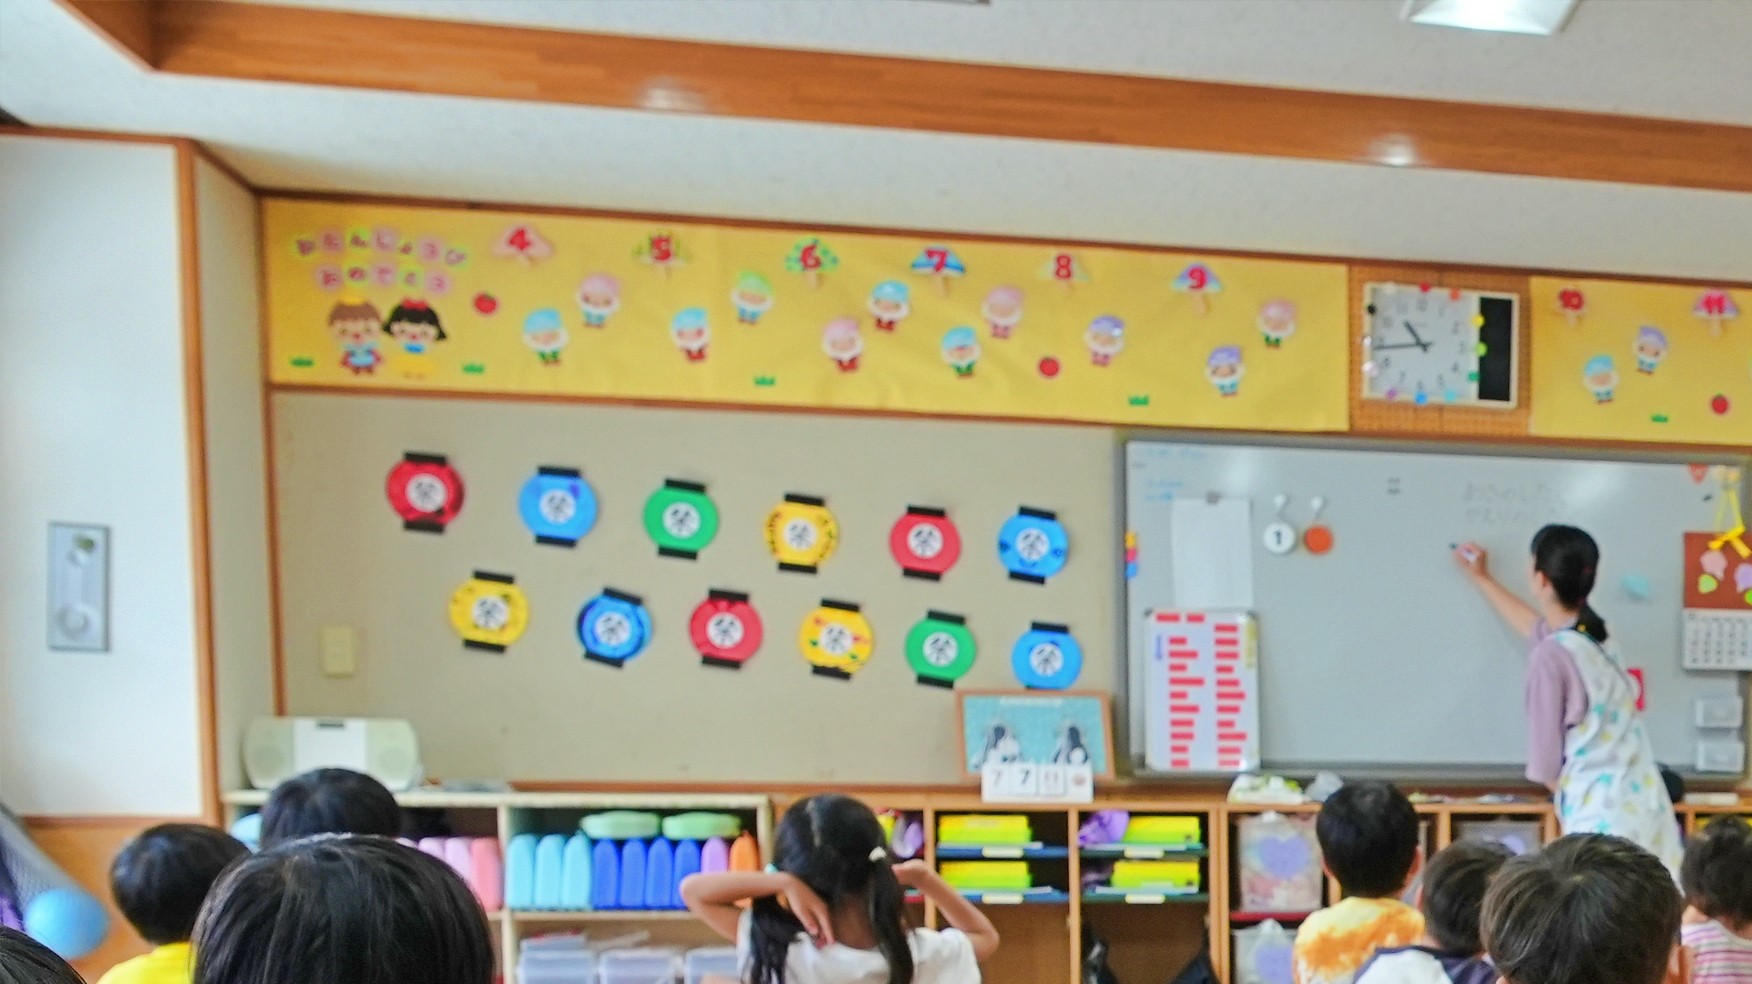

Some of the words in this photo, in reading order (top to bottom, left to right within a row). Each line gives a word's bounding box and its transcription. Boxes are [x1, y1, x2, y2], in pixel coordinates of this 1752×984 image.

[508, 227, 532, 251] 4
[653, 236, 672, 261] 5
[801, 245, 820, 269] 6
[926, 249, 947, 272] 7
[1056, 255, 1072, 280] 8
[1188, 267, 1207, 290] 9
[1273, 529, 1283, 546] 1
